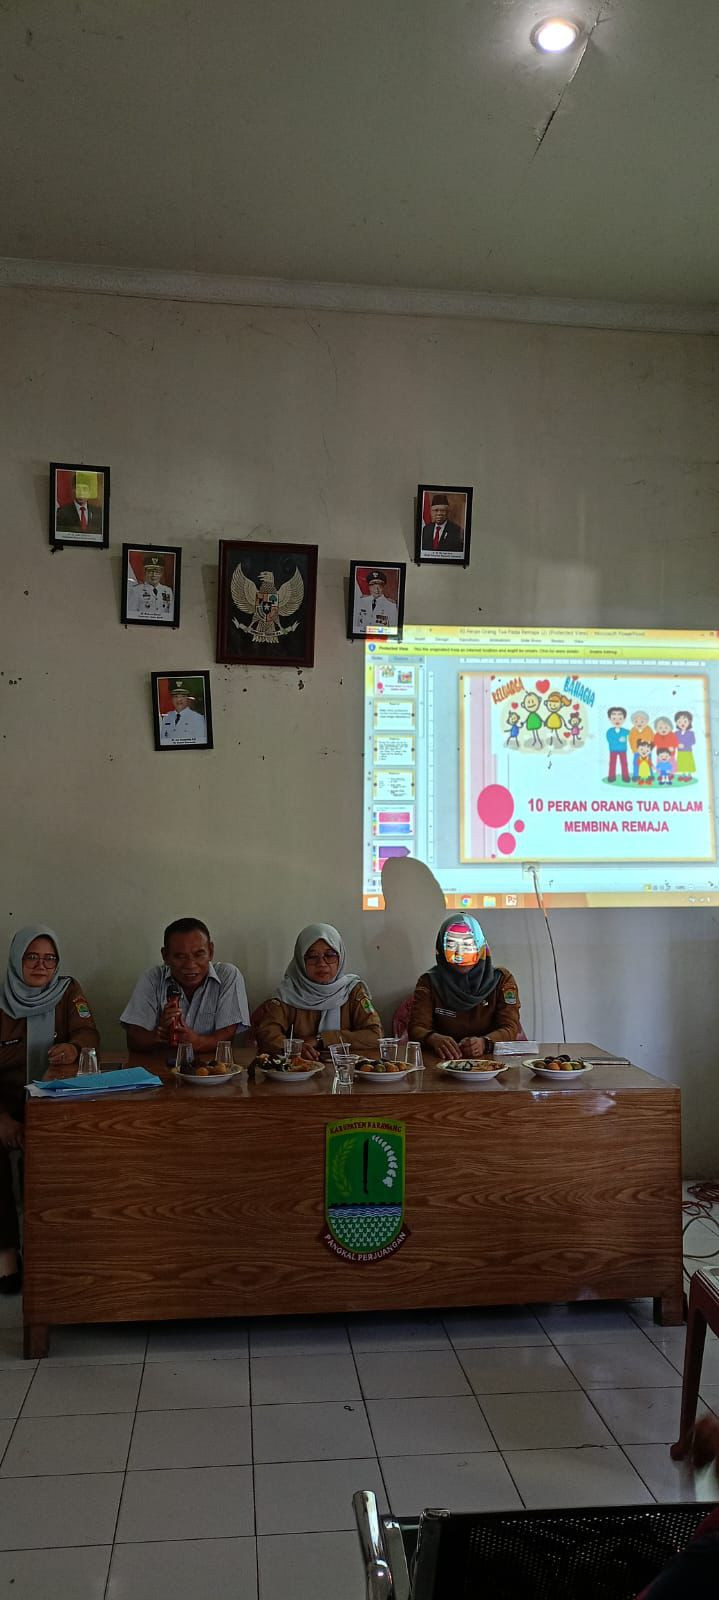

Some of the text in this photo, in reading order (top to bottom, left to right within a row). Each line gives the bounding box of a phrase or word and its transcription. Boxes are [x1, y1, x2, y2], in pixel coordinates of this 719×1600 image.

[563, 676, 595, 708] BAHAGIA
[528, 798, 703, 812] 10 PERAN ORANG TUA DALAM
[564, 821, 670, 833] MEMBINA REMAJA
[324, 1231, 407, 1261] PANGKAL PERJUANGAN
